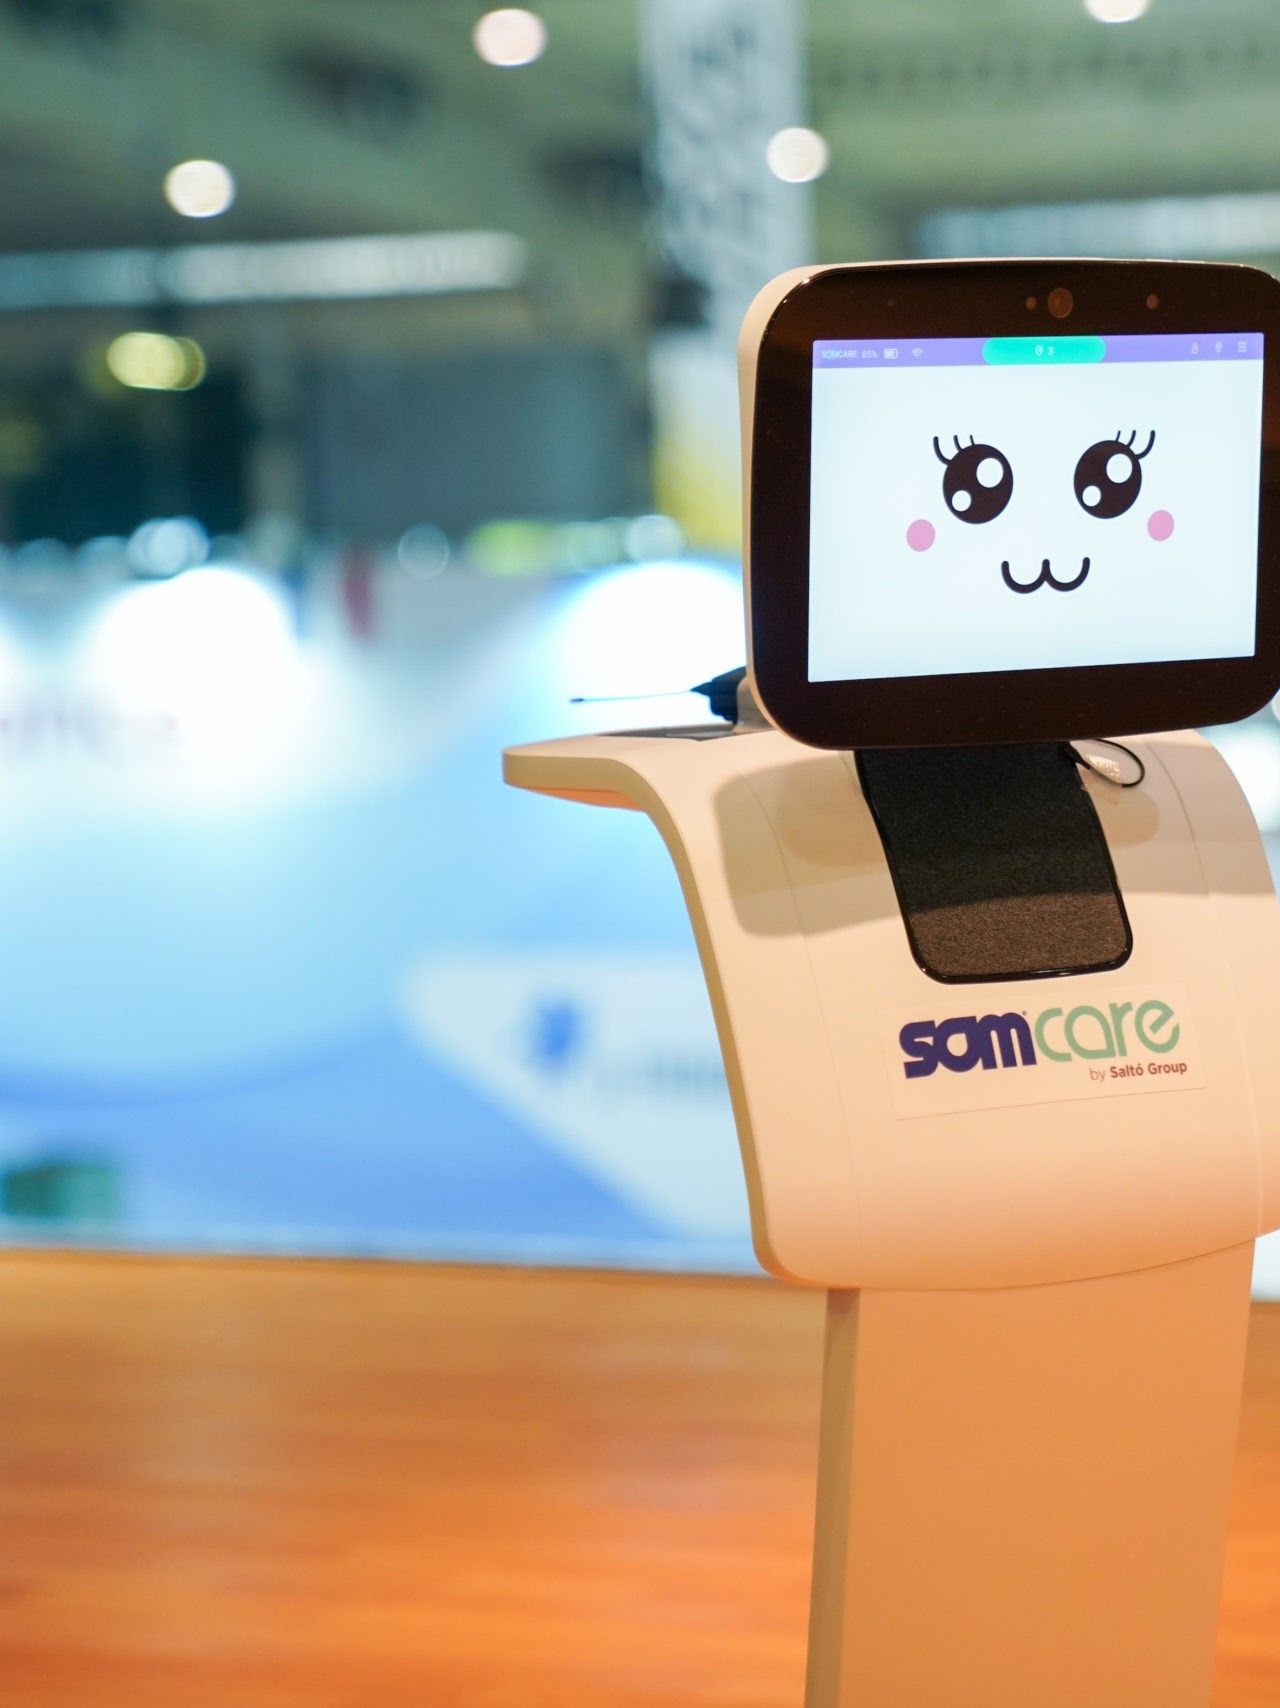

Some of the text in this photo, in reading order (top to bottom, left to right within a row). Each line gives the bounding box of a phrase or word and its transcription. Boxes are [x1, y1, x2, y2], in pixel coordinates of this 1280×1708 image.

[1089, 1062, 1187, 1083] by Saltó Group
